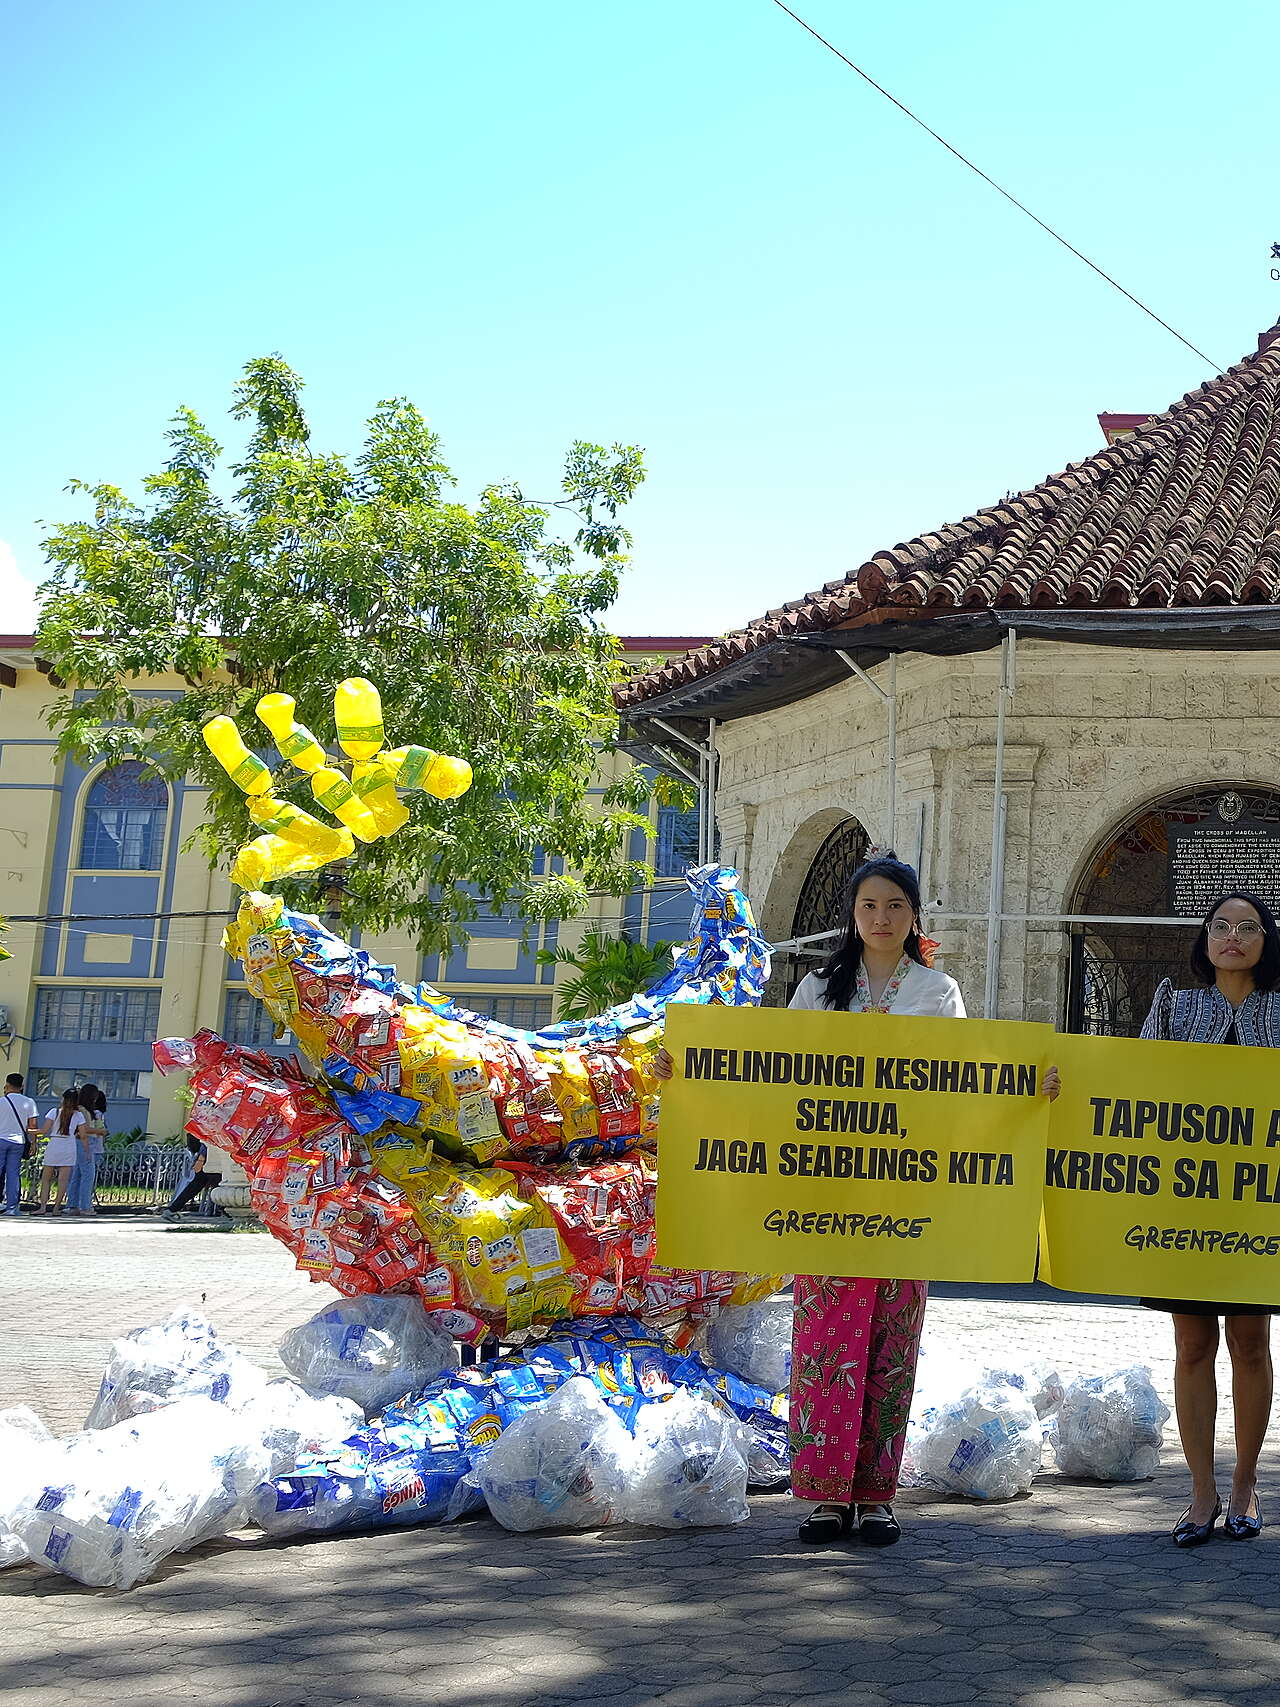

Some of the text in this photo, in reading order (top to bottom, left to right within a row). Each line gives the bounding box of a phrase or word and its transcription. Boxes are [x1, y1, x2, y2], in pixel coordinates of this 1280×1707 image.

[453, 1066, 479, 1083] Surf
[685, 1047, 1037, 1097] MELINDUNGI KESIHATAN
[796, 1098, 908, 1140] SEMUA,
[1089, 1097, 1255, 1147] TAPUSON
[694, 1138, 1014, 1186] JAGA SEABLINGS KITA
[1045, 1147, 1161, 1196] KRISIS
[1172, 1157, 1220, 1200] SA
[285, 1177, 306, 1188] Surf
[763, 1209, 932, 1239] GREENPEACE
[488, 1237, 513, 1258] Surf
[423, 1271, 448, 1285] Surf
[591, 1287, 617, 1297] Surf
[471, 1426, 499, 1446] Pride
[382, 1479, 426, 1514] WINGS
